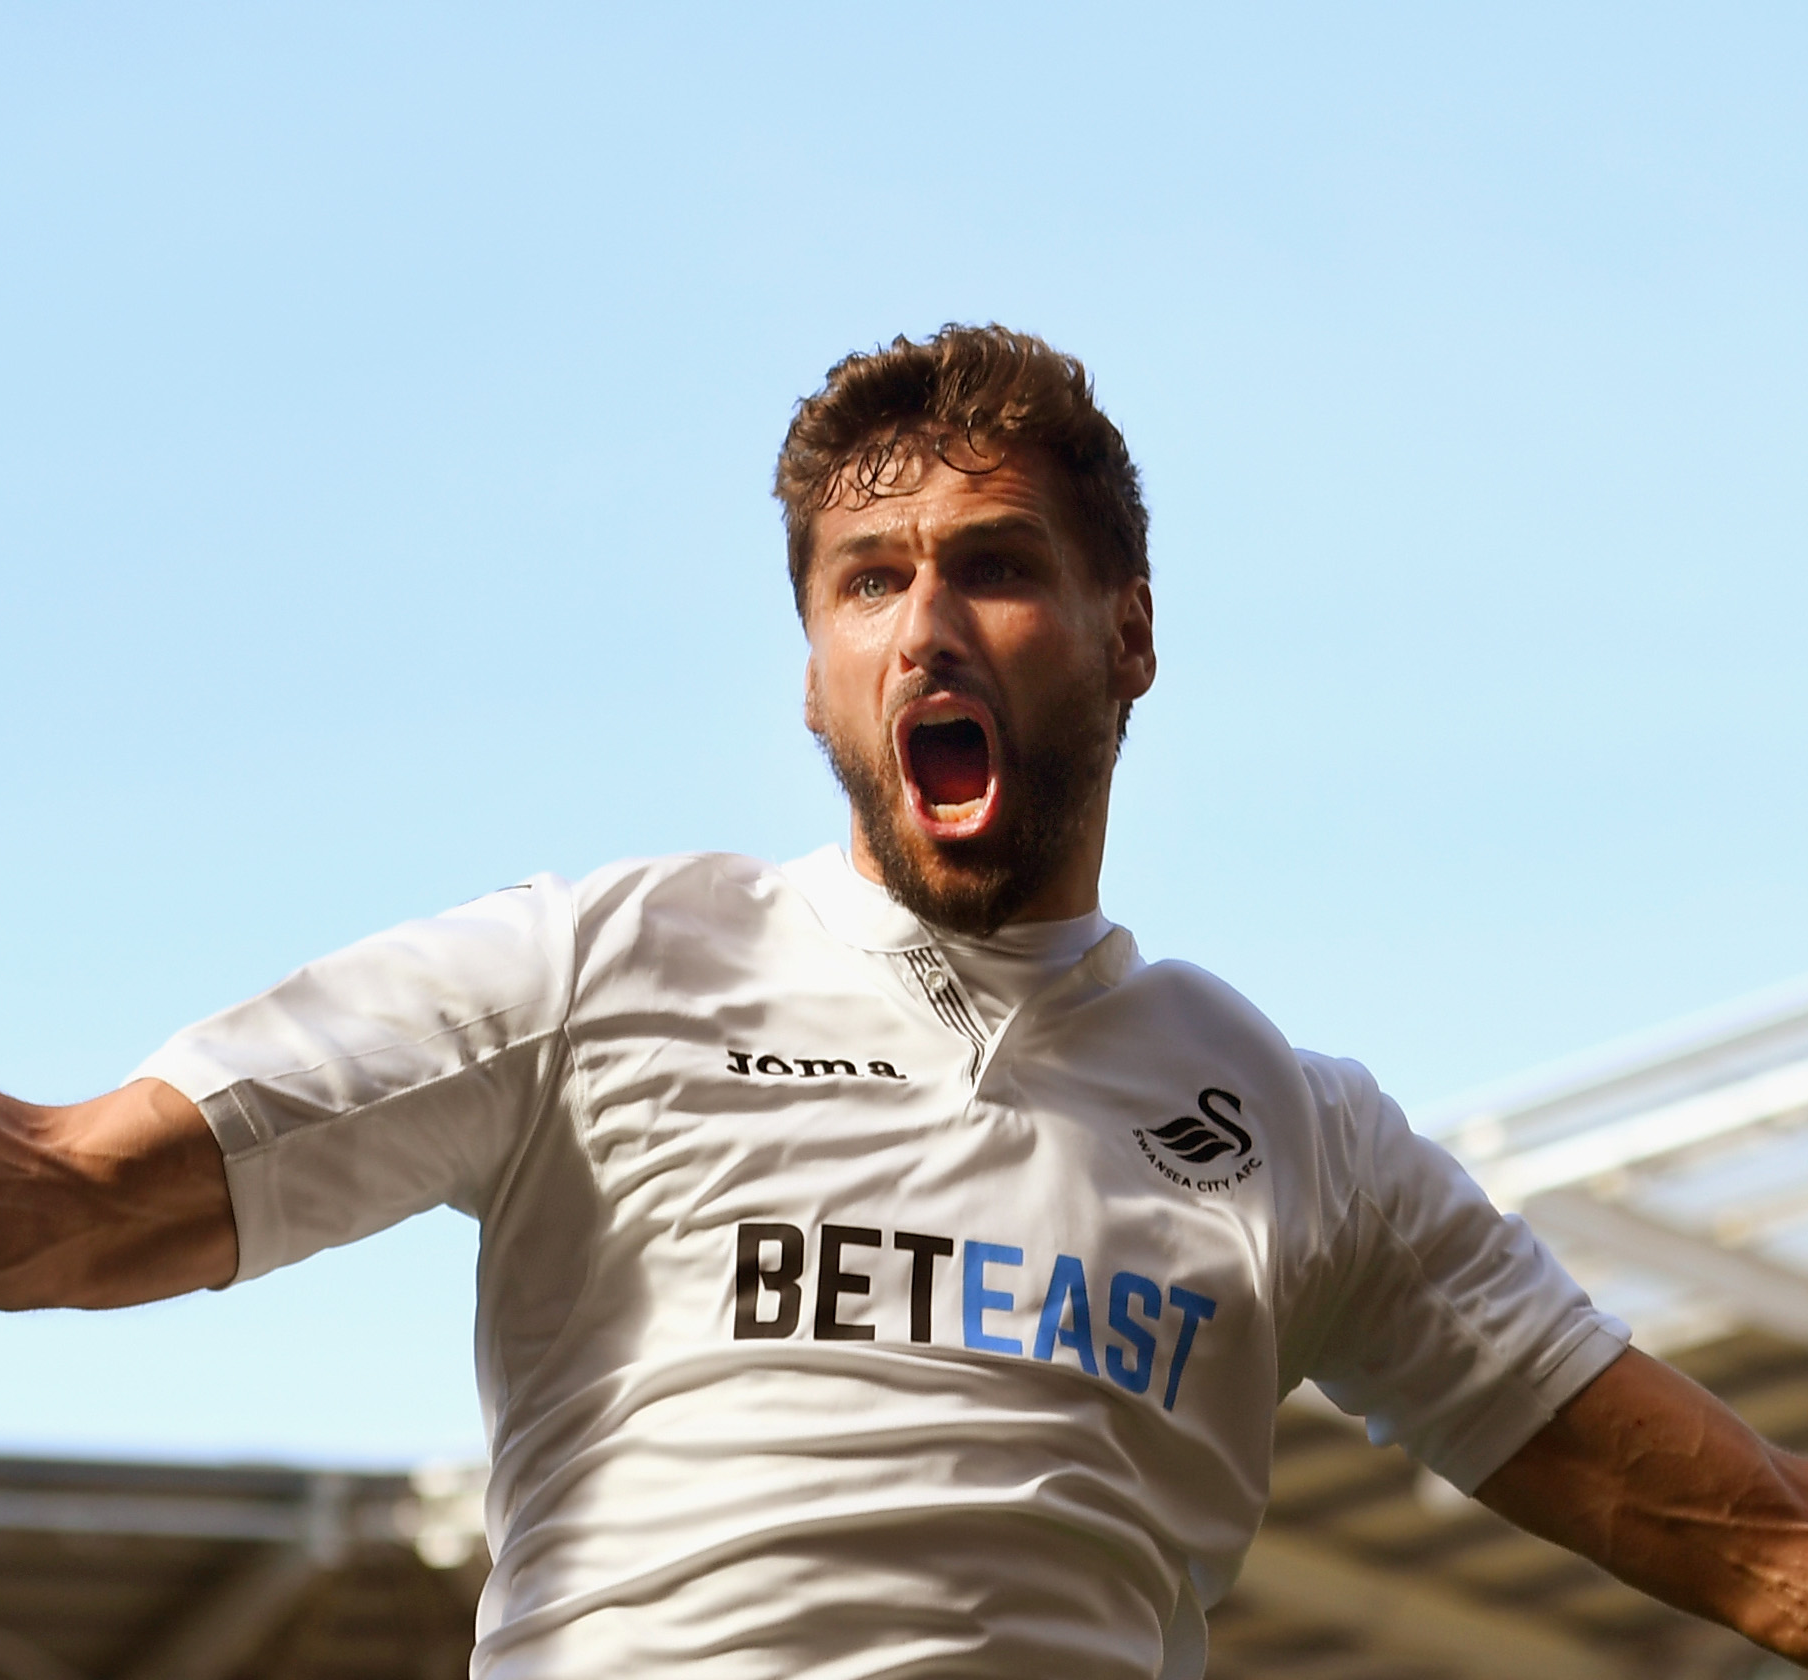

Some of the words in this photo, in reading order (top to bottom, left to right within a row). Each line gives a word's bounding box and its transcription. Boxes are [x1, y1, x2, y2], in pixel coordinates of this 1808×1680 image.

[1132, 1128, 1192, 1190] SWANSEA
[1197, 1178, 1230, 1193] CITY
[1235, 1157, 1263, 1184] AFC
[733, 1222, 1217, 1412] BETEAST
